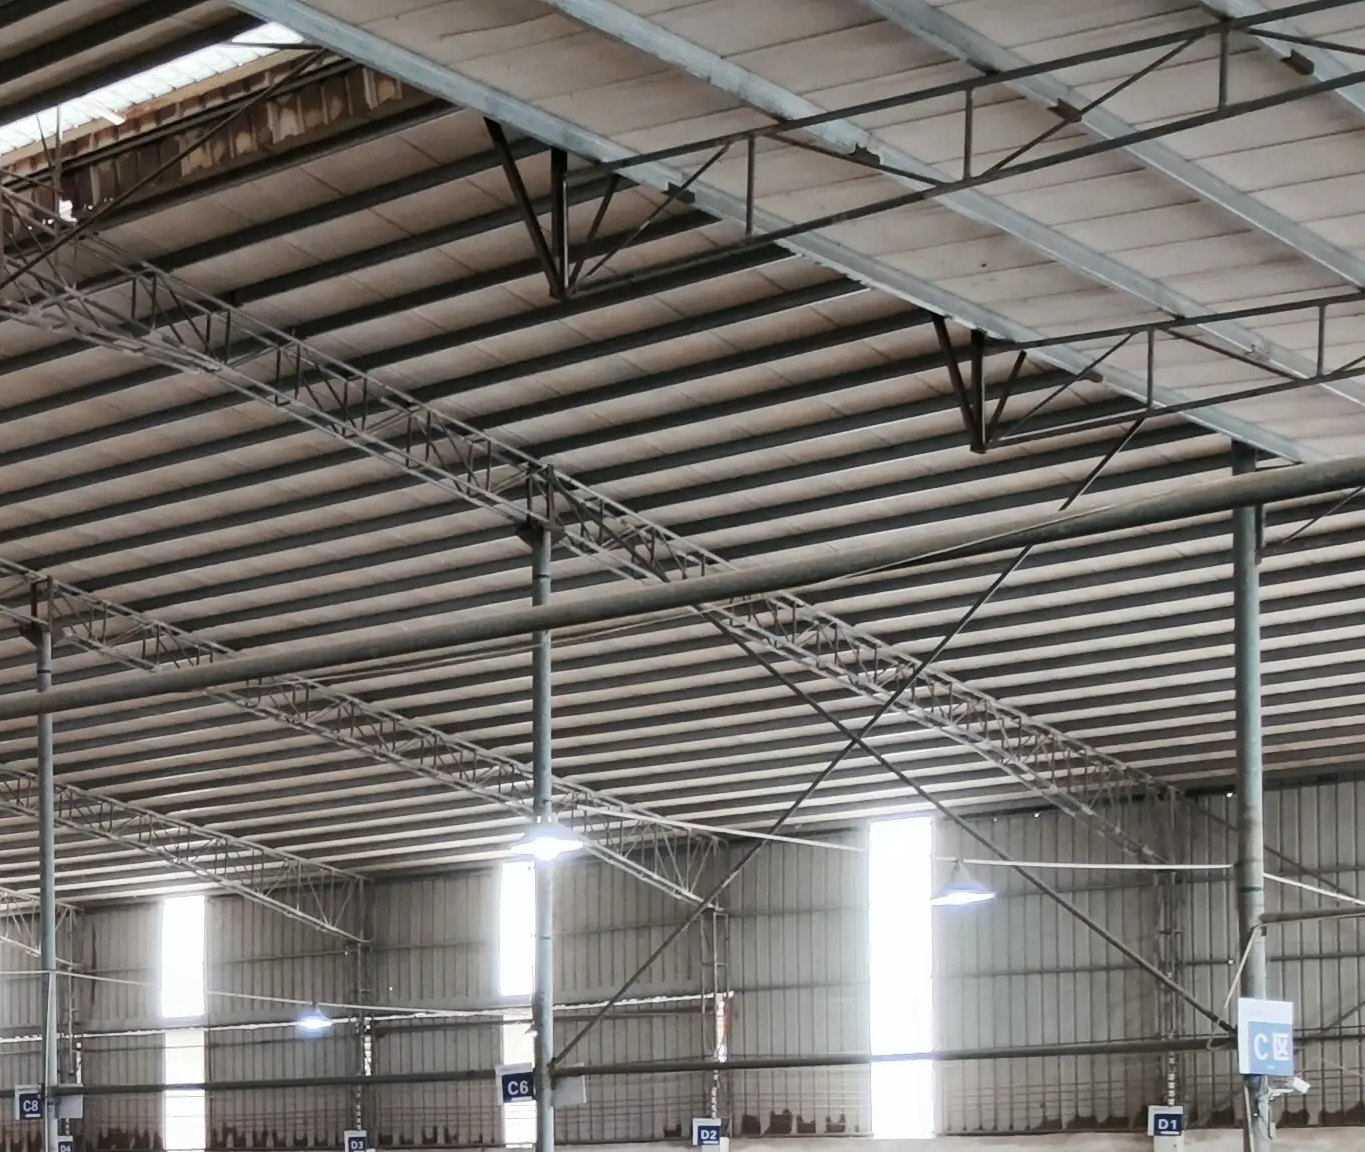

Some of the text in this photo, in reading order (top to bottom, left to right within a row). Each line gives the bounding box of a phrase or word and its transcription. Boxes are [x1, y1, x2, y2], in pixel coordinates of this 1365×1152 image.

[507, 1080, 529, 1096] C6
[22, 1100, 39, 1113] C8
[1157, 1118, 1178, 1130] D1
[700, 1129, 718, 1140] D2
[350, 1141, 364, 1151] D3
